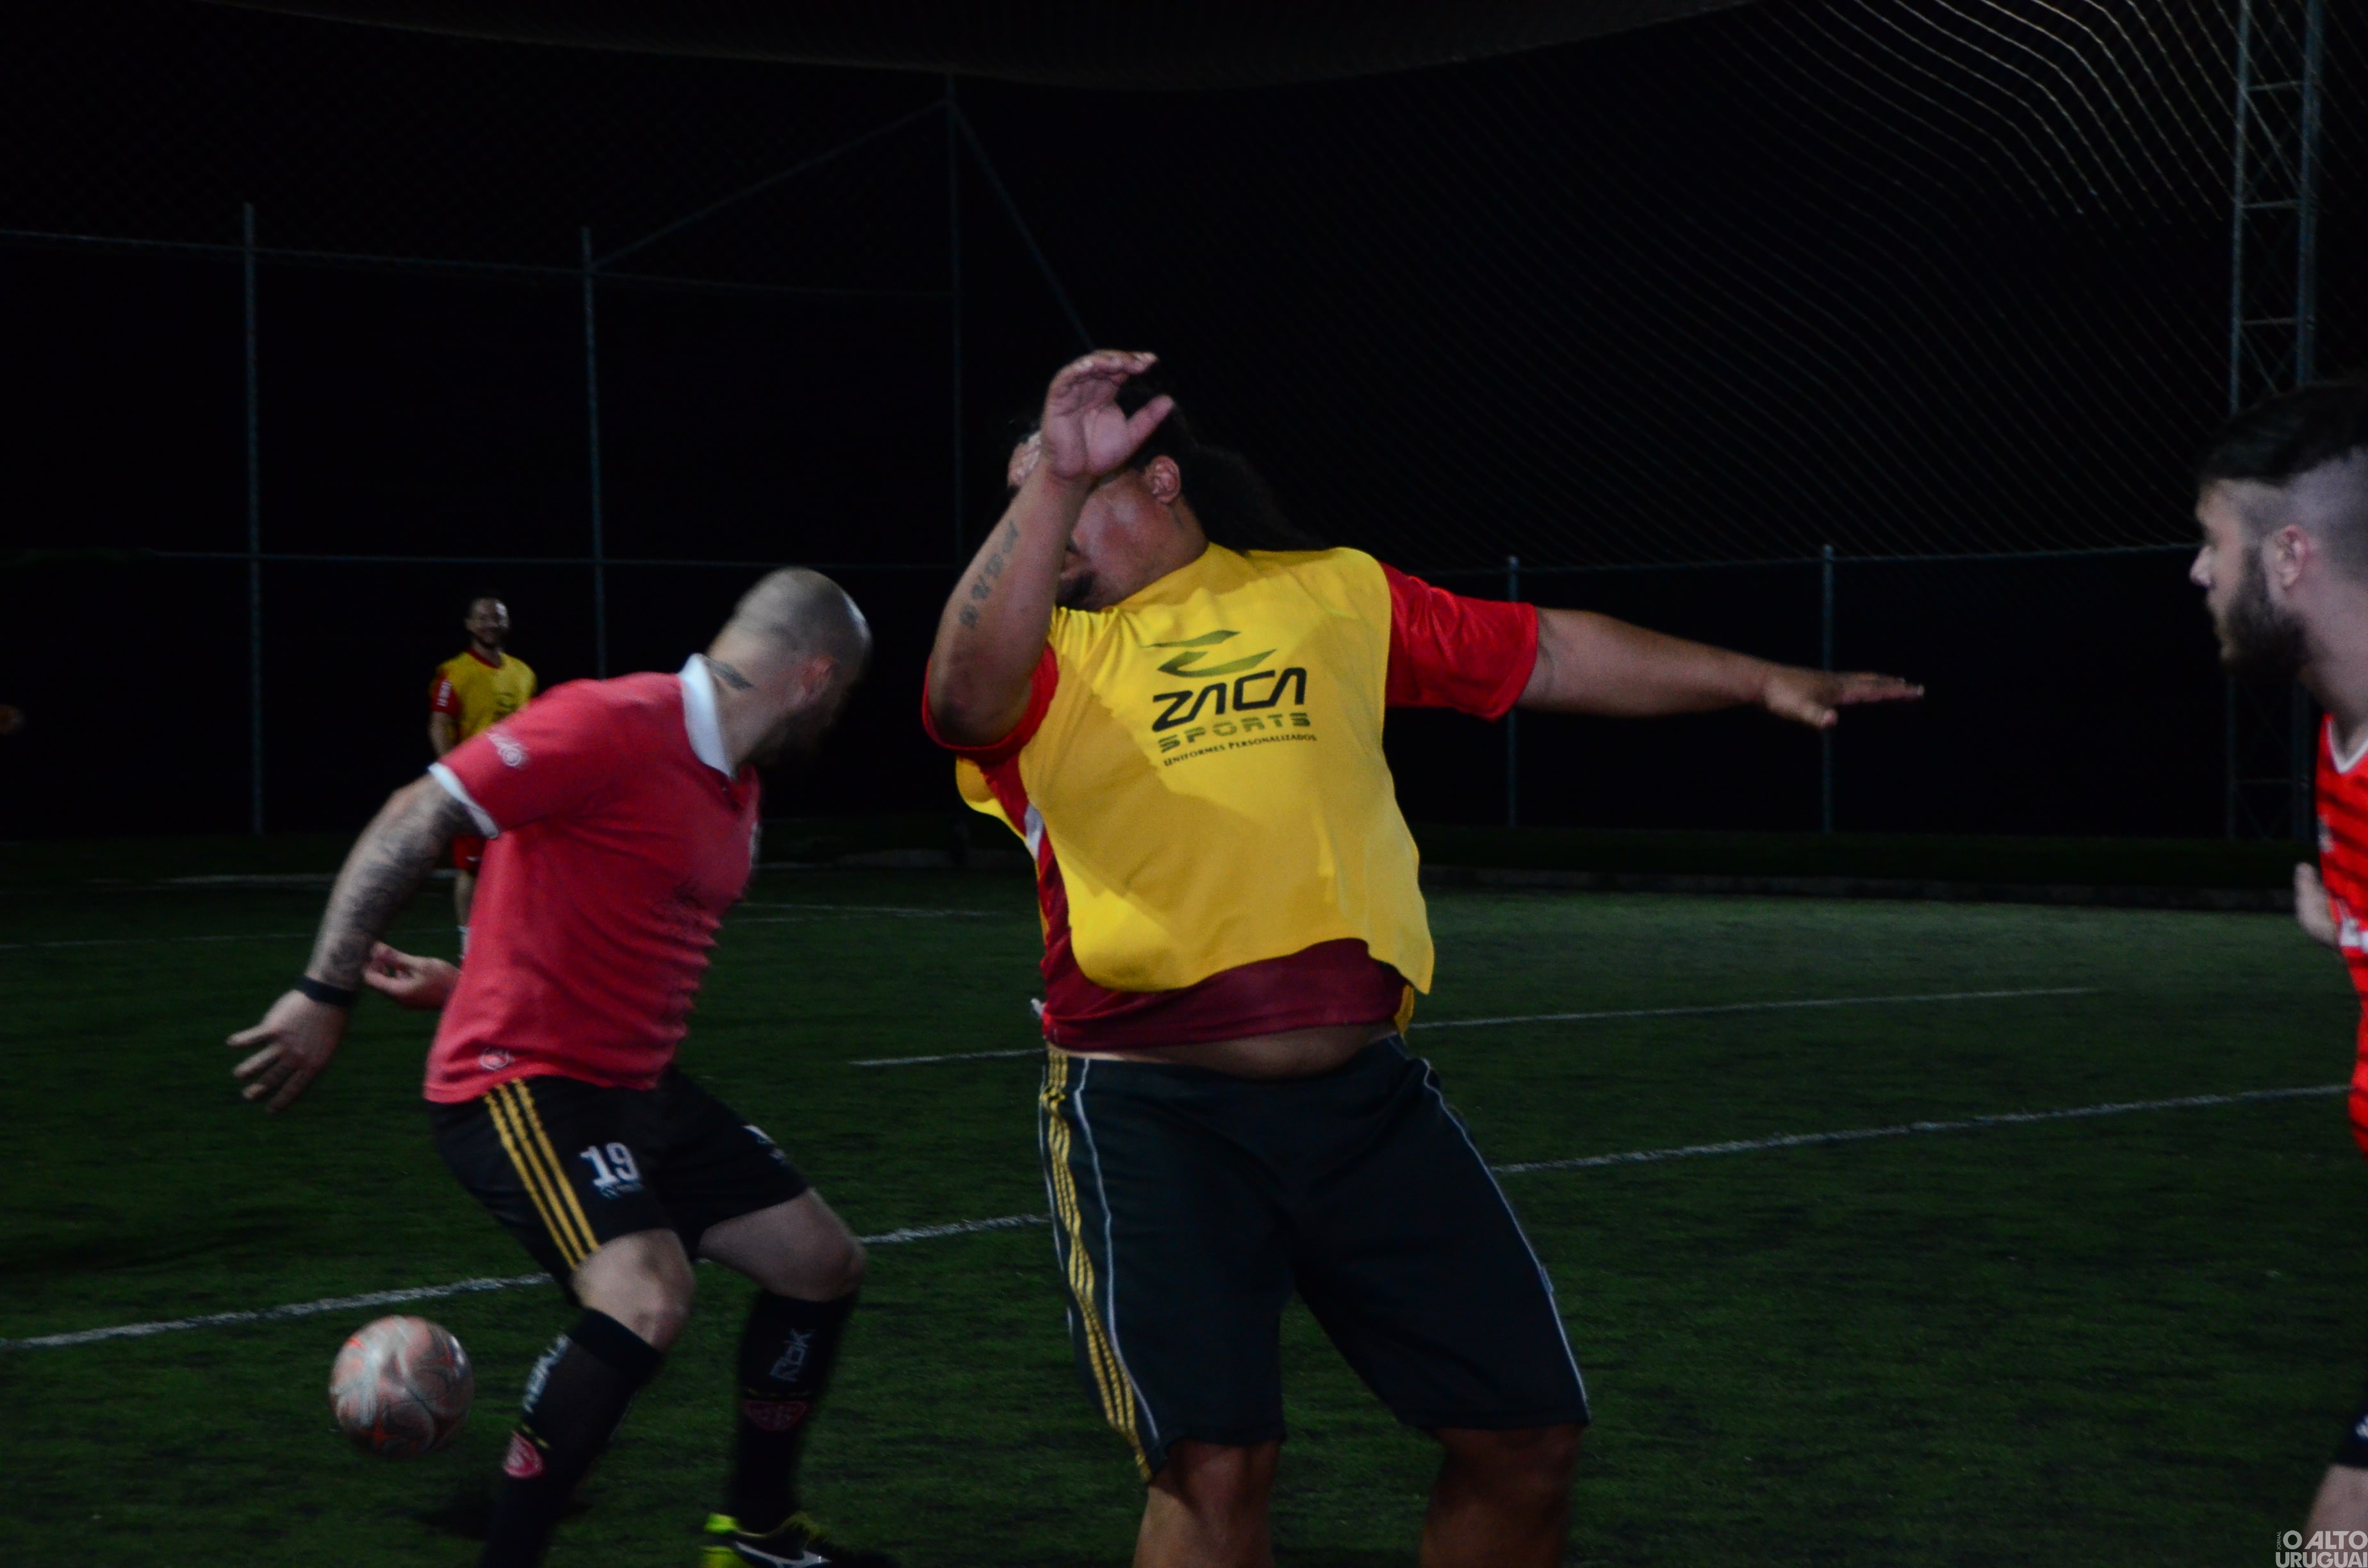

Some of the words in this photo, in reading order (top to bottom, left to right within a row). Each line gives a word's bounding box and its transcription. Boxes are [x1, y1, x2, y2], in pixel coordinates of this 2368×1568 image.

[1152, 667, 1307, 732] ZACA
[1158, 712, 1311, 753] SPORTS
[579, 1141, 640, 1186] 19
